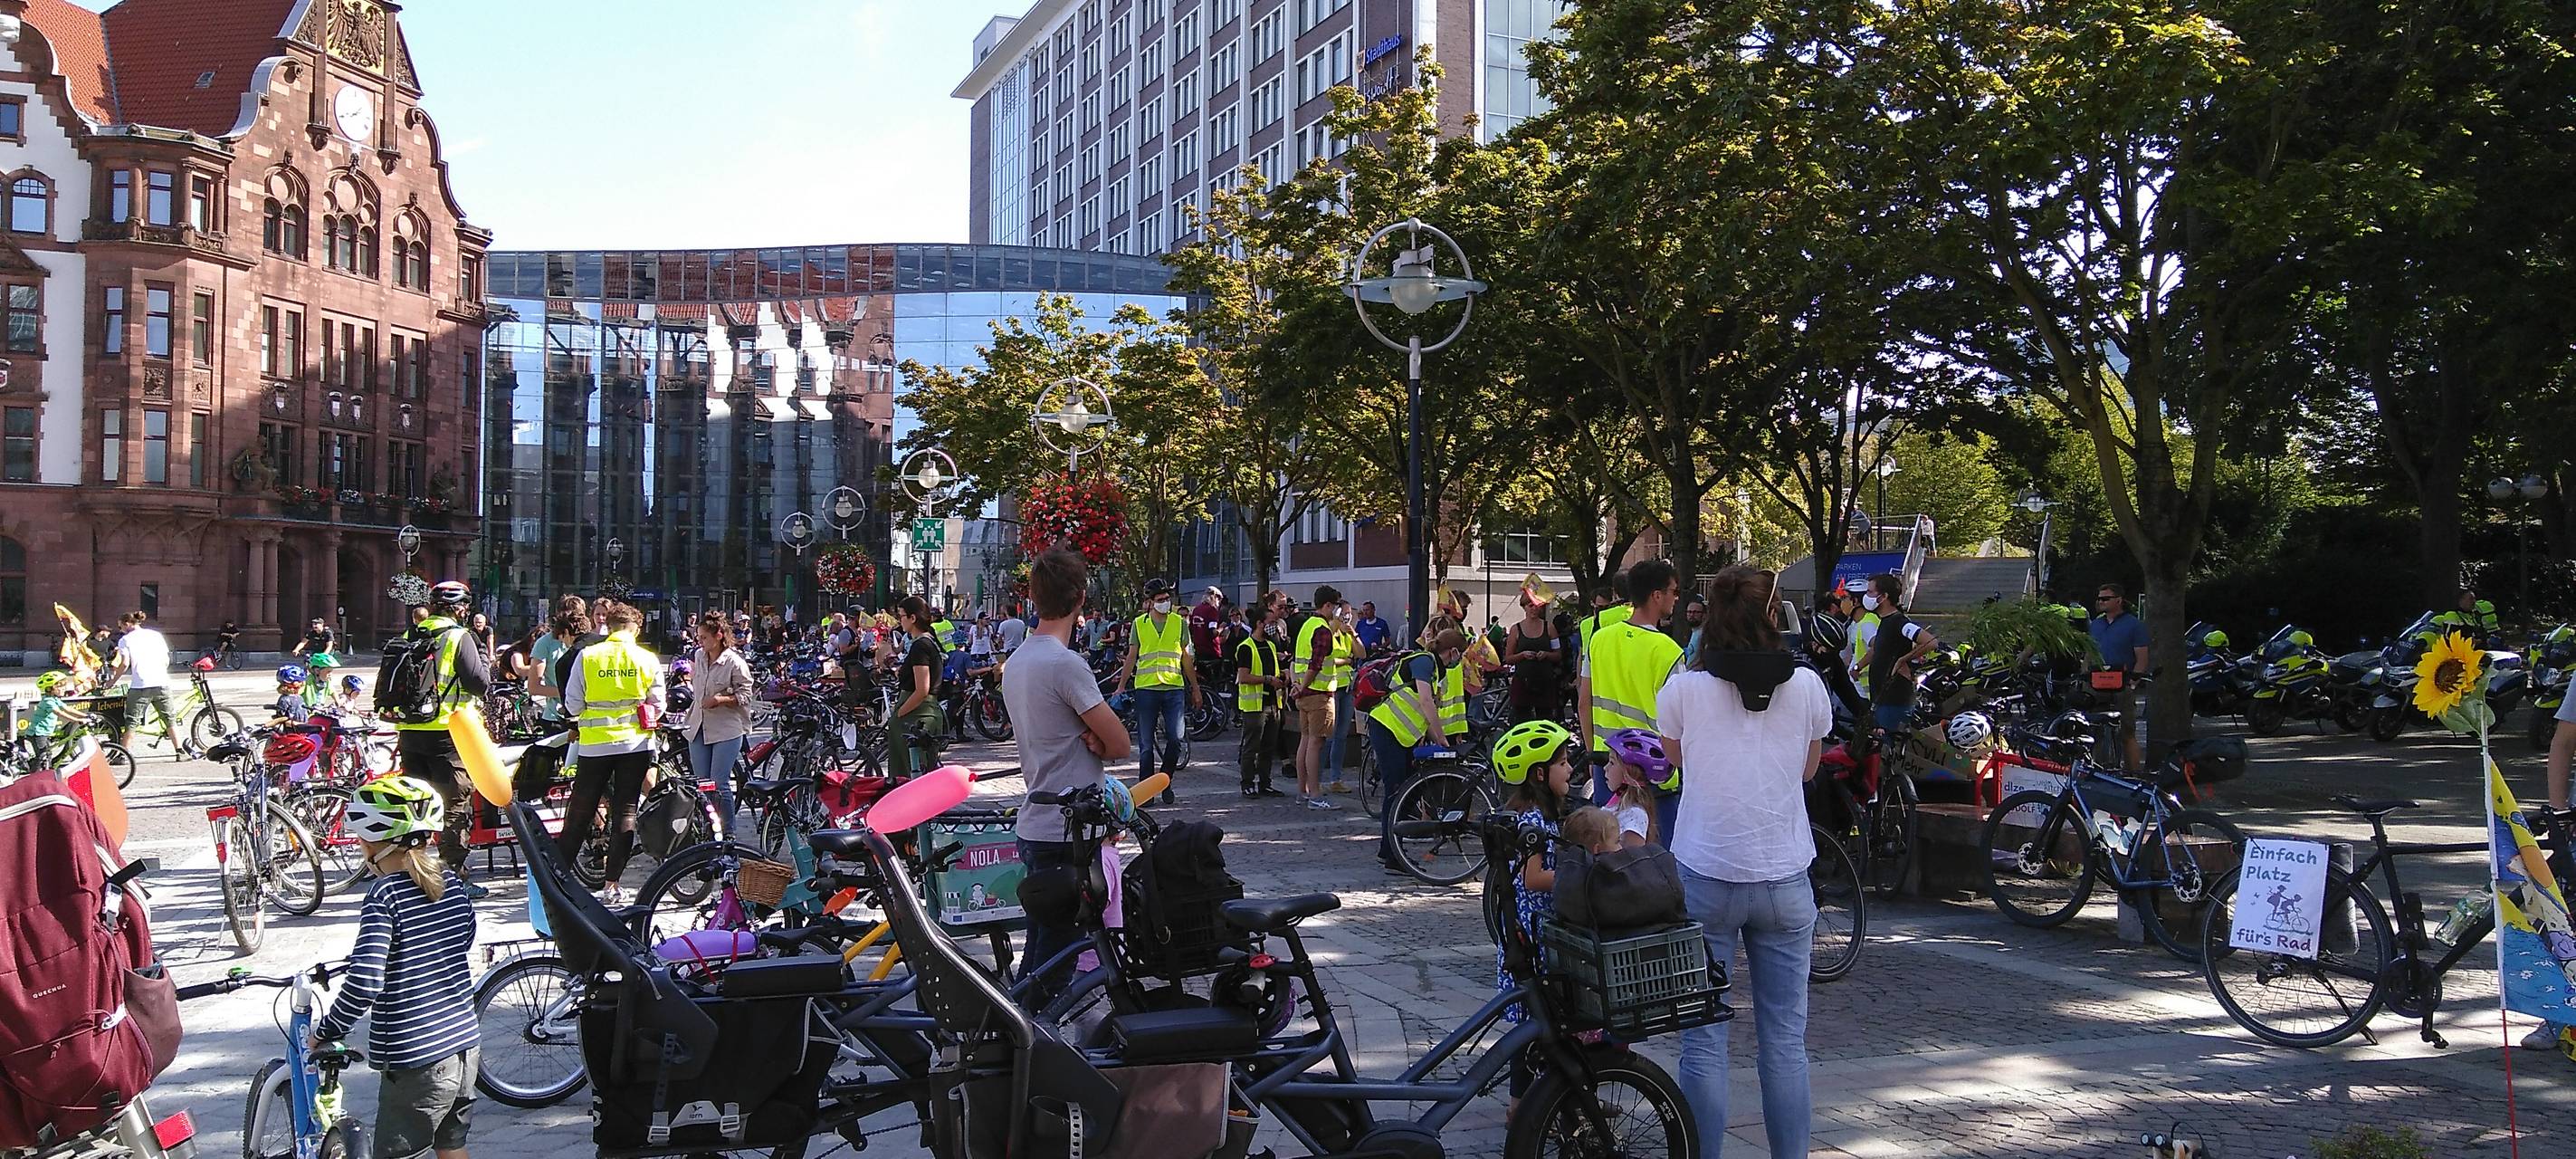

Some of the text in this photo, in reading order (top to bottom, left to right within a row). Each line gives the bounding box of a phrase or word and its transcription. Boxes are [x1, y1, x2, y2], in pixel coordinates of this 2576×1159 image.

[1366, 34, 1400, 64] Stadthaus
[1836, 563, 1862, 571] PARKEN
[969, 849, 1000, 867] NOLA
[2250, 847, 2317, 865] Einfach
[2246, 866, 2291, 883] Platz
[2237, 928, 2311, 952] für's Rad
[33, 983, 67, 999] QUECHUA
